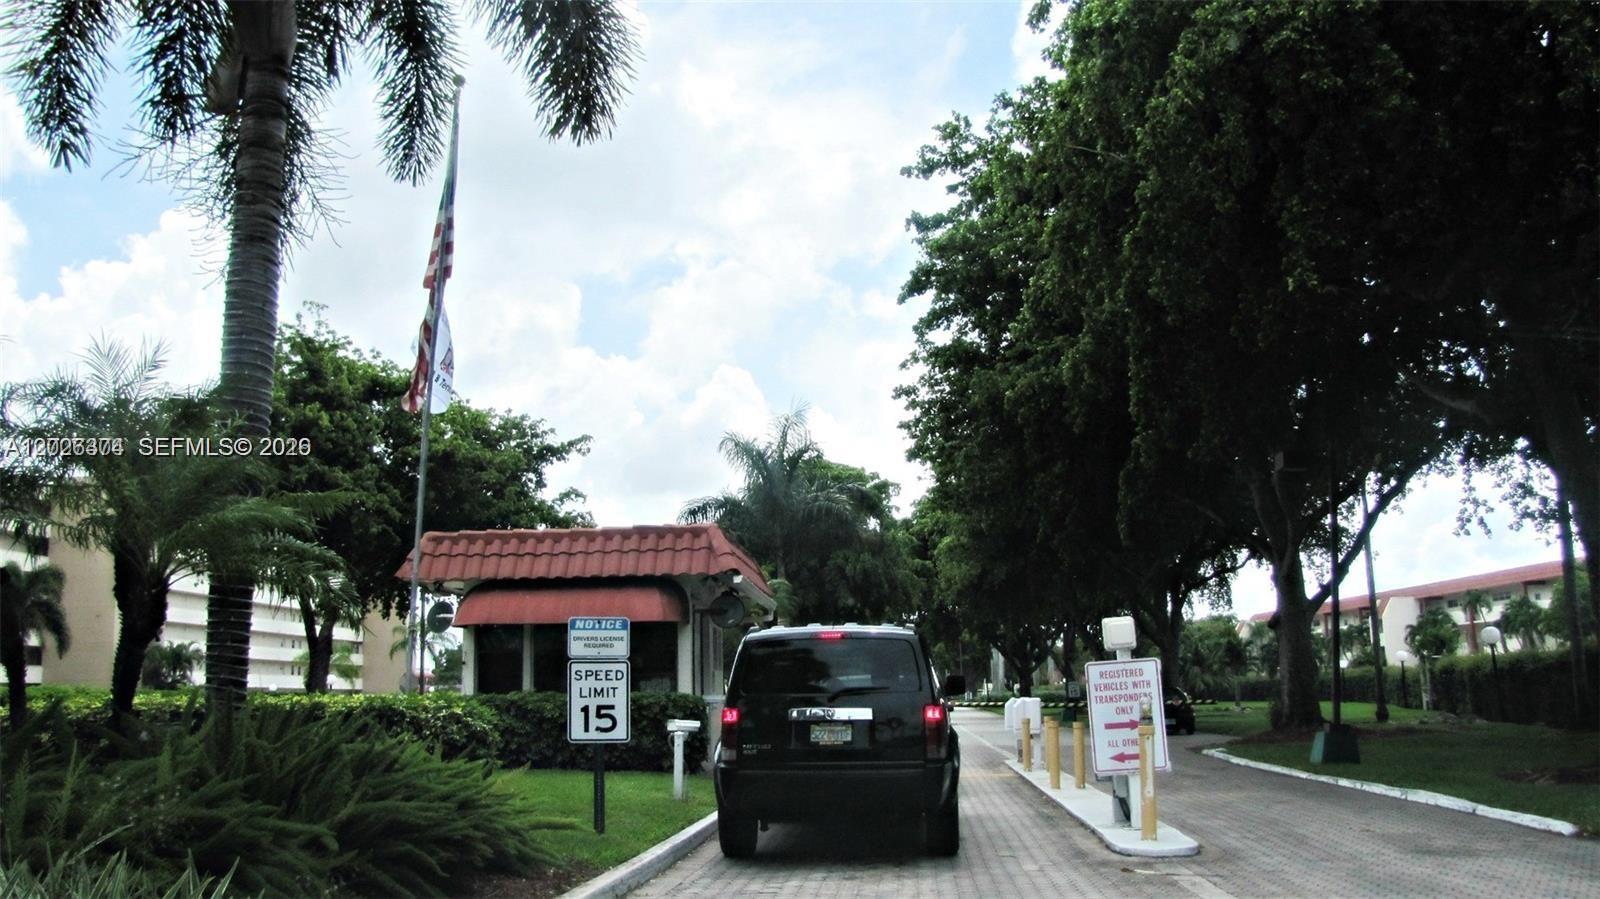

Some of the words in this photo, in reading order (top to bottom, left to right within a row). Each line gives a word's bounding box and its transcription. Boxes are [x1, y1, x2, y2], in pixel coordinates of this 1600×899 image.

[575, 620, 623, 629] NOTICE
[574, 670, 624, 681] SPEED
[1099, 668, 1144, 679] REGISTERED
[1094, 682, 1129, 692] VEHICLES
[1132, 680, 1151, 690] WITH
[579, 687, 618, 699] LIMIT
[1116, 706, 1134, 716] ONLY
[580, 705, 617, 733] 15
[1107, 739, 1120, 748] ALL
[1122, 738, 1140, 747] OTHE
